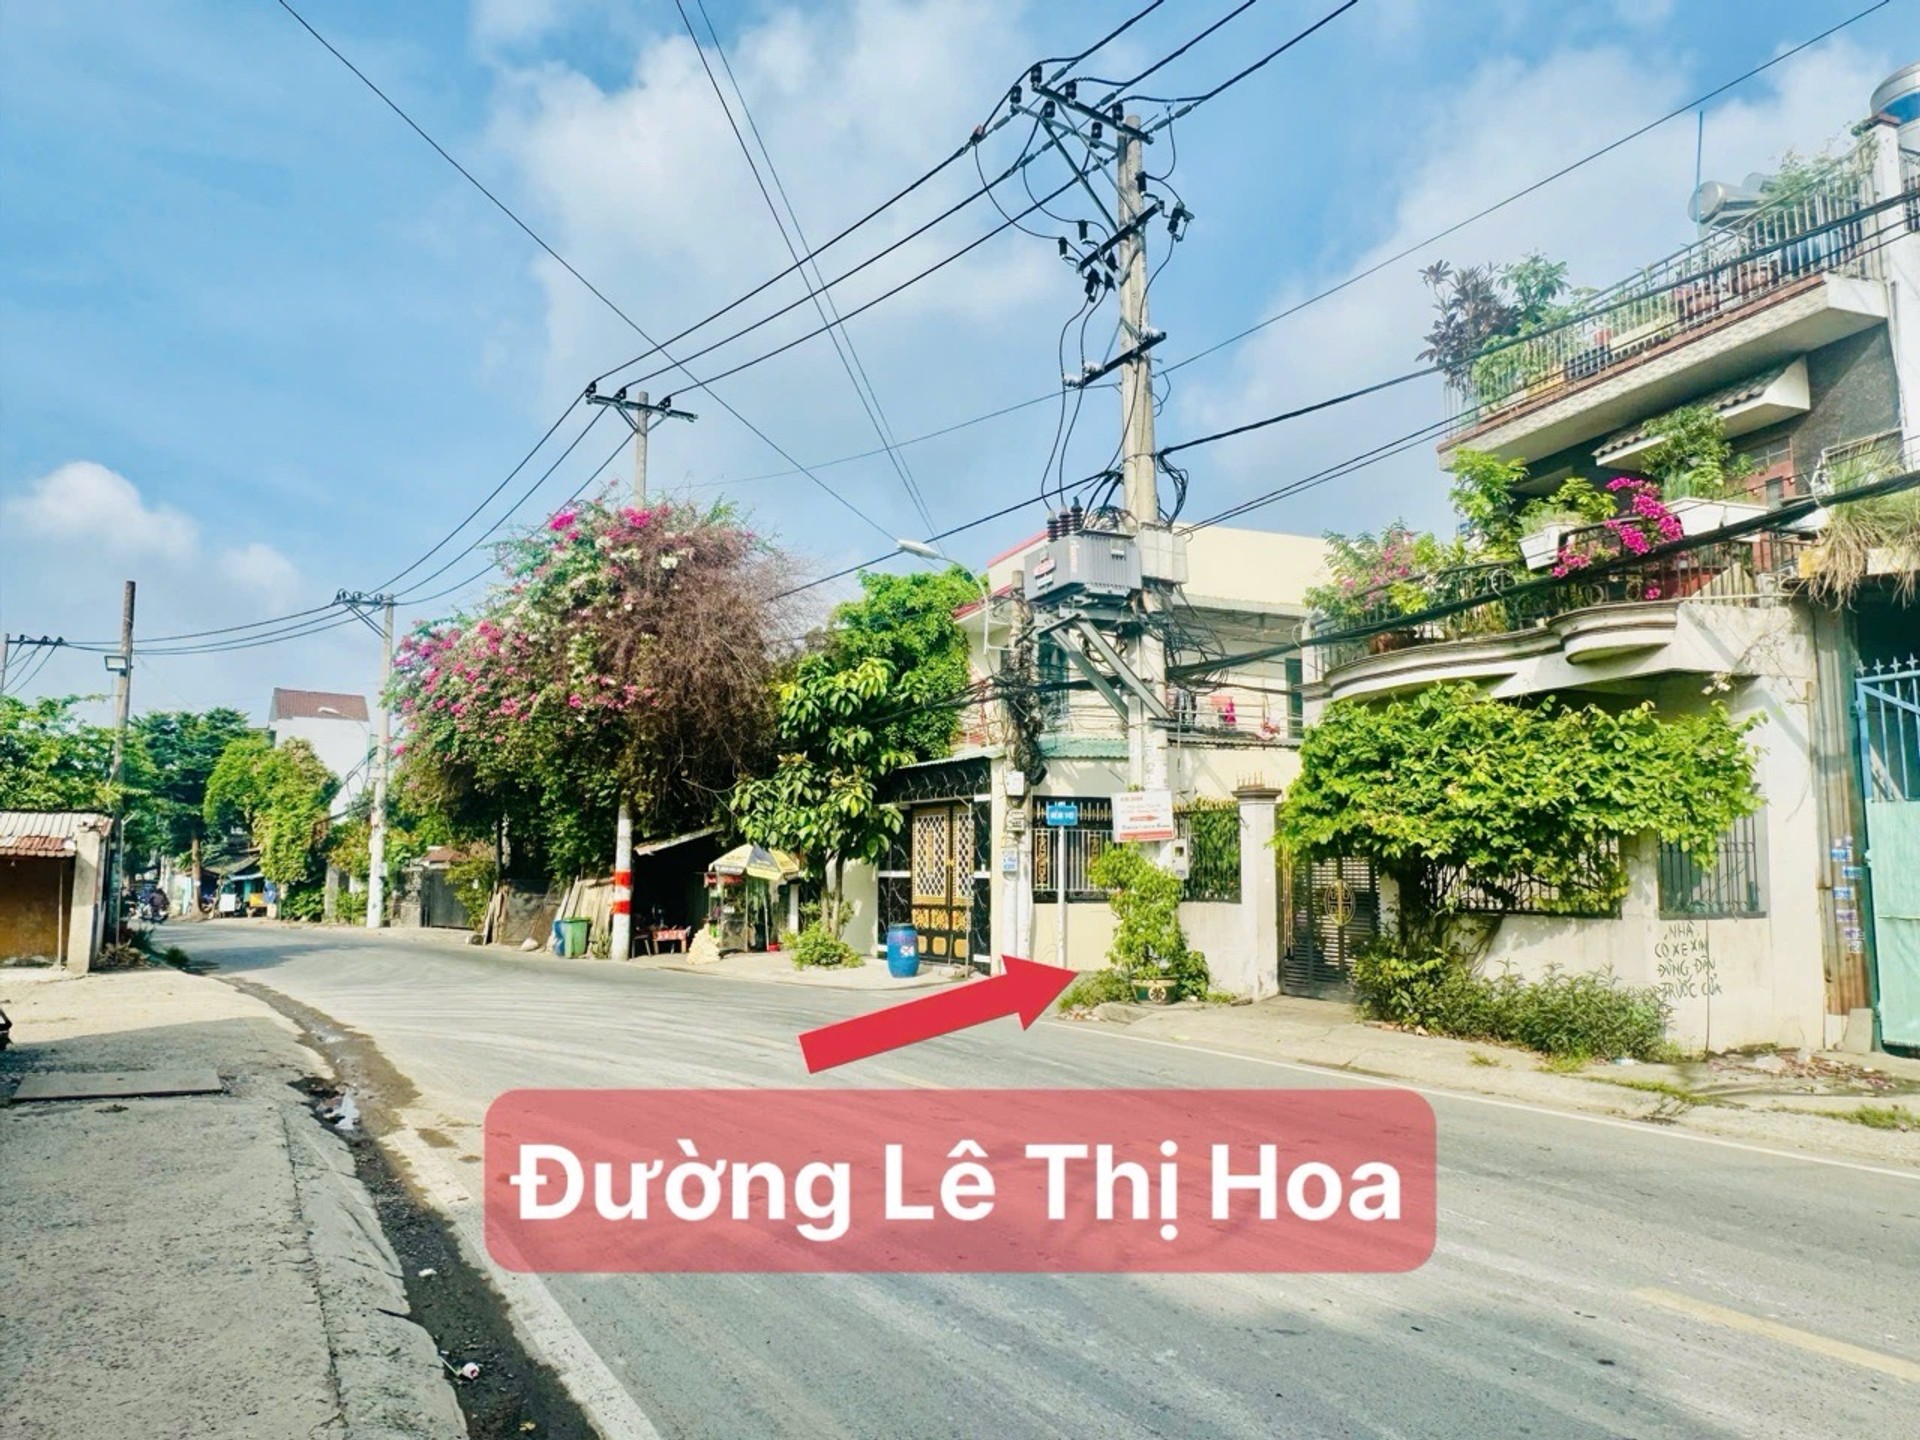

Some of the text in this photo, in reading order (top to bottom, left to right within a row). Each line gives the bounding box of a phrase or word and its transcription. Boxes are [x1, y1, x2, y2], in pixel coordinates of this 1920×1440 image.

[1669, 920, 1695, 938] NHÀ
[1654, 934, 1670, 958] CÓ
[1672, 942, 1688, 957] XE
